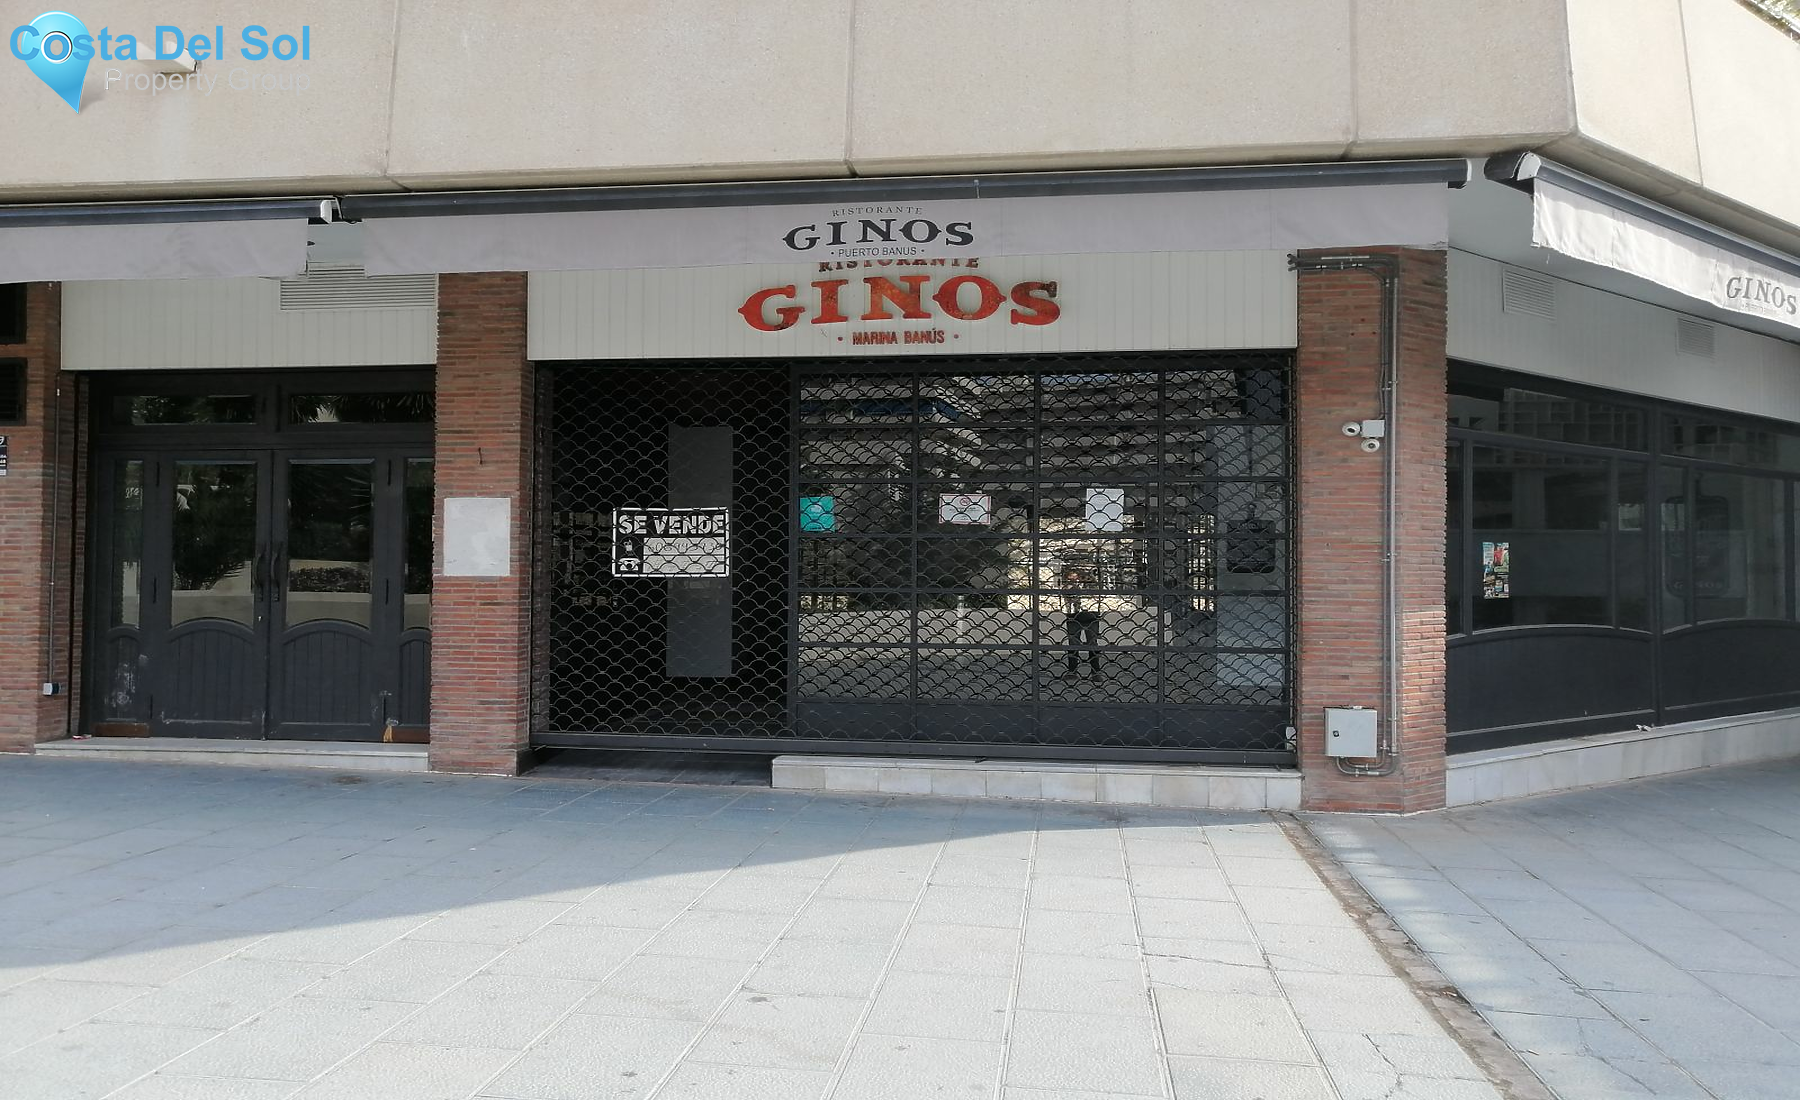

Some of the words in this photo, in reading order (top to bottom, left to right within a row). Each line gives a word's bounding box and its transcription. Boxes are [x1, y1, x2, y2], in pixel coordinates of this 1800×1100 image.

[832, 206, 923, 217] RISTORANTE
[782, 218, 974, 250] GINOS
[838, 248, 880, 257] PUERTO
[882, 247, 917, 256] BANUS
[737, 275, 1061, 332] GINOS
[1726, 276, 1797, 315] GINOS
[852, 331, 898, 345] MARINA
[619, 515, 647, 534] SE
[654, 515, 724, 534] VENDE
